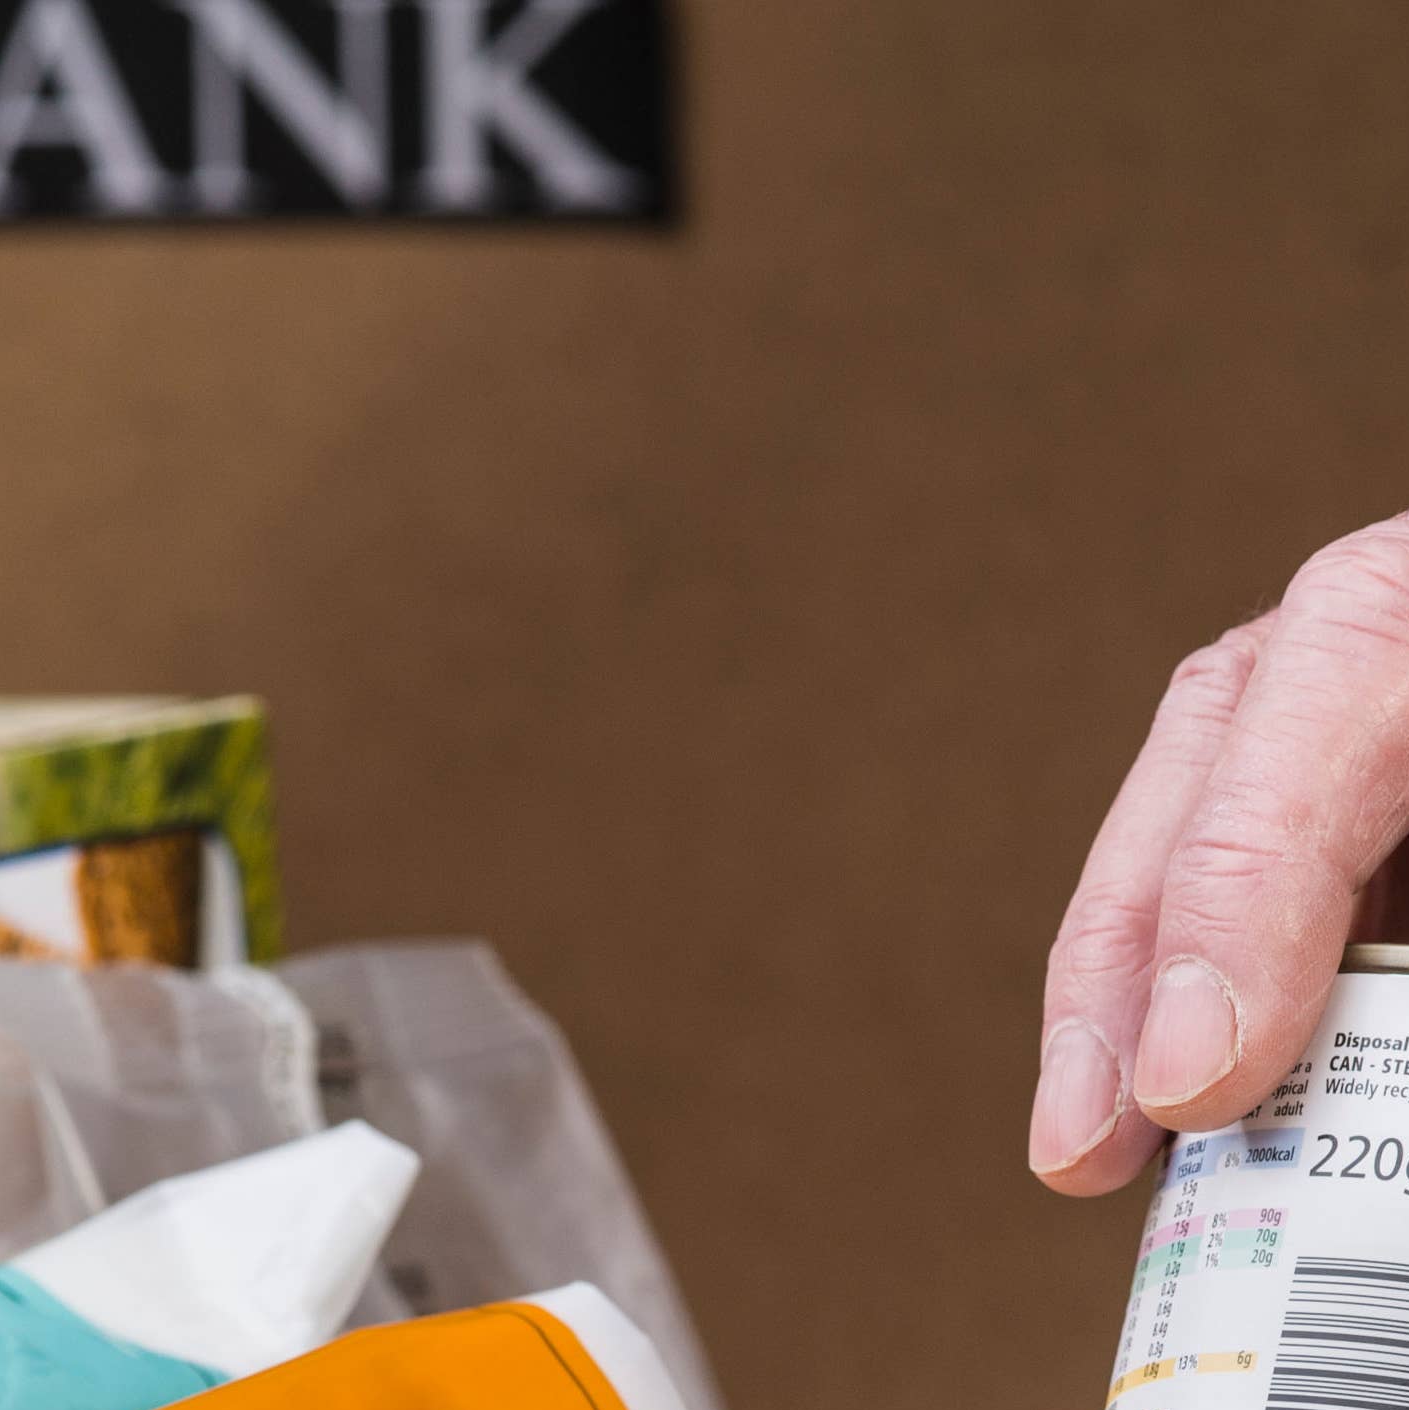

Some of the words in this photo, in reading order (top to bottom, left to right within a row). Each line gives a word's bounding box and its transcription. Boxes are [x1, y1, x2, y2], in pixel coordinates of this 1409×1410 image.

[1334, 1032, 1409, 1052] Disposal
[1330, 1056, 1364, 1072] CAN
[1325, 1079, 1378, 1097] Widely
[1245, 1146, 1295, 1164] 2000kcal
[1260, 1208, 1282, 1226] 90g
[1256, 1229, 1277, 1247] 70g
[1251, 1248, 1273, 1265] 20g
